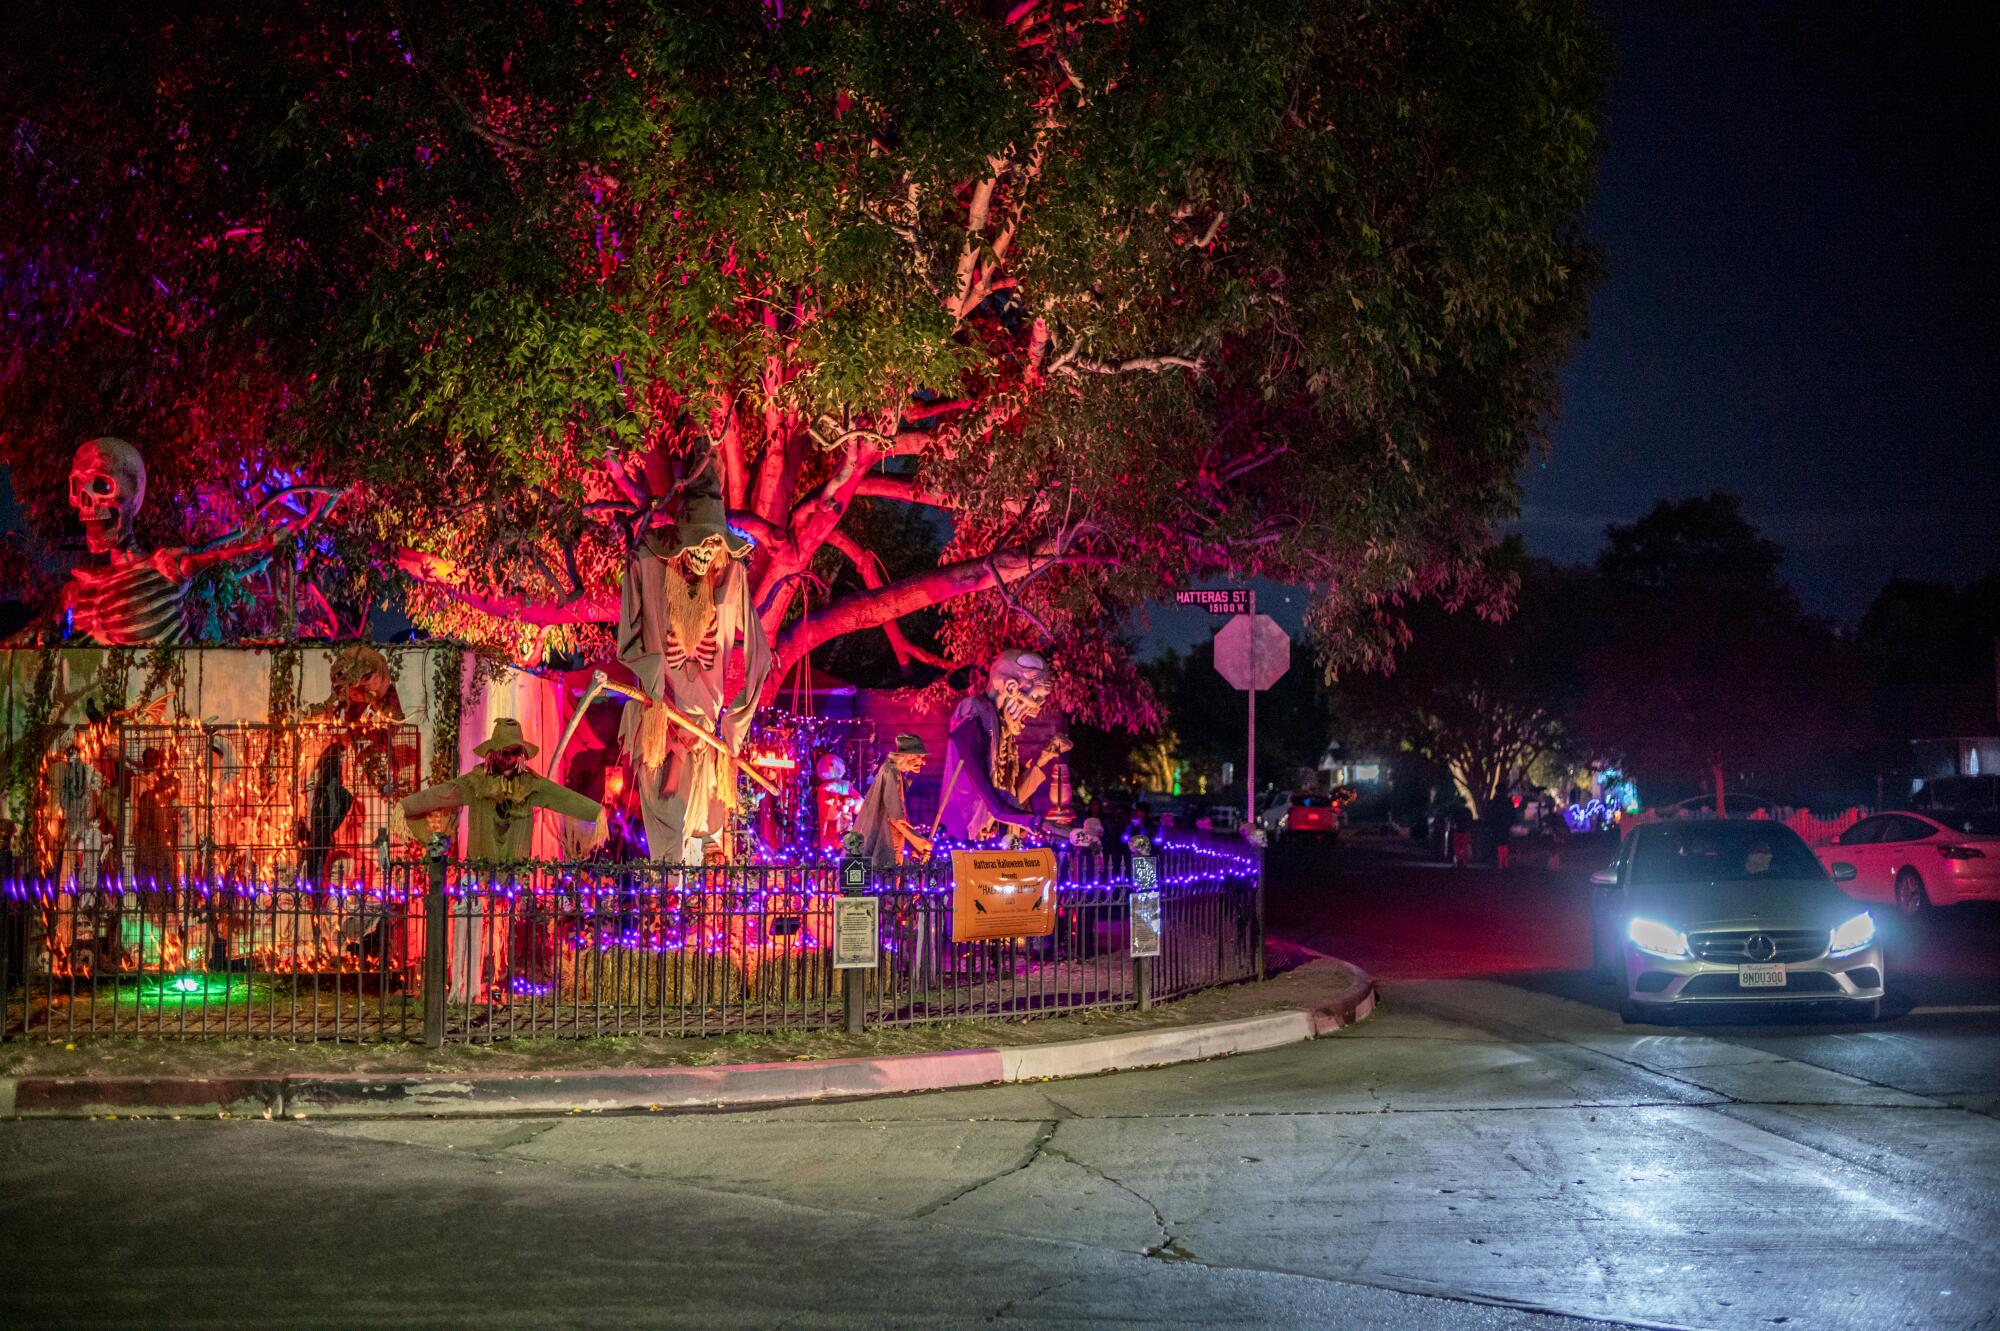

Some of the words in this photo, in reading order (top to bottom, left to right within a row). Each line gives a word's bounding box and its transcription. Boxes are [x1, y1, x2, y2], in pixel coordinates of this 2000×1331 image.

[1176, 591, 1229, 603] HATTERAS
[1232, 591, 1248, 603] ST.
[1209, 603, 1235, 613] 15100
[973, 859, 997, 869] Hatteras
[997, 858, 1024, 869] Halloween
[1024, 857, 1041, 867] House
[1742, 972, 1783, 984] 8NDU300
